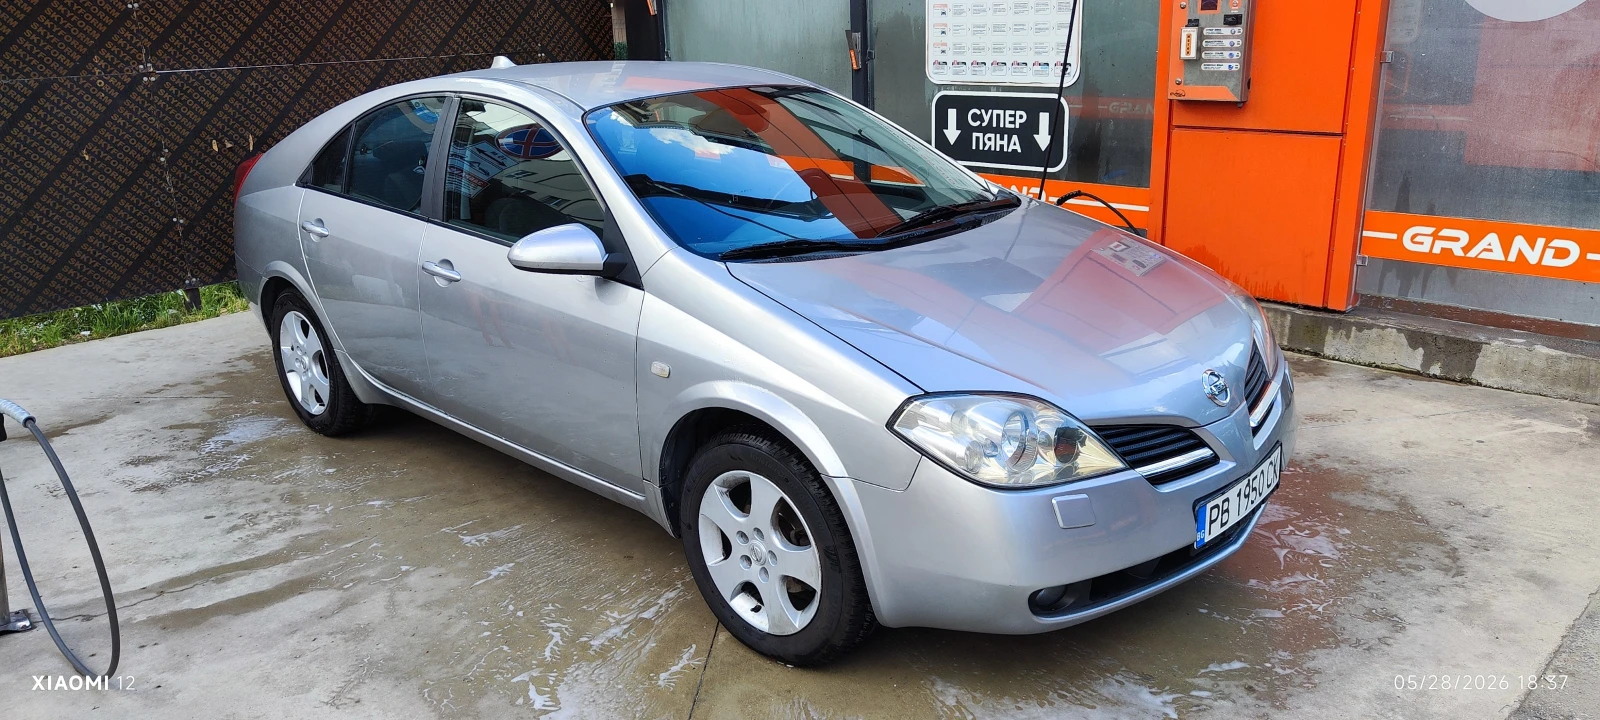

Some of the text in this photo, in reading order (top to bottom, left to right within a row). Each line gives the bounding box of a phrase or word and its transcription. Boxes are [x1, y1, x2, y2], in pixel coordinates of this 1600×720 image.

[44, 6, 94, 47] SKYFORM
[51, 0, 100, 40] SKYFORM
[187, 15, 229, 52] SKYFORM
[193, 8, 235, 46] SKYFORM
[199, 2, 241, 39] SKYFORM
[268, 14, 306, 50] SKYFORM
[274, 8, 311, 43] SKYFORM
[279, 1, 317, 37] SKYFORM
[342, 13, 376, 47] SKYFORM
[347, 7, 381, 41] SKYFORM
[352, 1, 386, 35] SKYFORM
[409, 12, 441, 45] SKYFORM
[414, 6, 446, 39] SKYFORM
[419, 0, 450, 33] SKYFORM
[23, 29, 74, 68] SKYFORM
[30, 21, 80, 61] SKYFORM
[37, 14, 87, 54] SKYFORM
[175, 29, 217, 66] SKYFORM
[181, 22, 223, 59] SKYFORM
[256, 27, 295, 62] SKYFORM
[262, 20, 300, 56] SKYFORM
[331, 25, 366, 59] SKYFORM
[336, 19, 371, 53] SKYFORM
[400, 24, 432, 56] SKYFORM
[404, 18, 437, 50] SKYFORM
[16, 36, 67, 75] SKYFORM
[170, 75, 212, 110] SKYFORM
[245, 77, 284, 111] SKYFORM
[251, 70, 290, 104] SKYFORM
[326, 66, 361, 98] SKYFORM
[38, 97, 87, 134] SKYFORM
[44, 90, 93, 126] SKYFORM
[51, 82, 100, 119] SKYFORM
[153, 96, 195, 131] SKYFORM
[158, 88, 201, 124] SKYFORM
[164, 82, 206, 117] SKYFORM
[228, 97, 268, 130] SKYFORM
[234, 90, 273, 124] SKYFORM
[240, 83, 279, 117] SKYFORM
[1109, 102, 1154, 114] GRAN
[24, 112, 74, 148] SKYFORM
[31, 105, 80, 141] SKYFORM
[111, 113, 156, 148] SKYFORM
[117, 106, 162, 140] SKYFORM
[223, 104, 262, 137] SKYFORM
[968, 108, 1027, 128] СУПЕР
[4, 135, 54, 170] SKYFORM
[10, 127, 61, 163] SKYFORM
[17, 120, 67, 156] SKYFORM
[92, 135, 138, 169] SKYFORM
[98, 128, 144, 162] SKYFORM
[105, 120, 150, 155] SKYFORM
[194, 138, 235, 171] SKYFORM
[972, 132, 1022, 152] ПЯНА
[73, 157, 120, 191] SKYFORM
[86, 142, 132, 176] SKYFORM
[176, 159, 218, 192] SKYFORM
[182, 152, 224, 185] SKYFORM
[188, 145, 229, 178] SKYFORM
[53, 179, 101, 212] SKYFORM
[60, 172, 107, 205] SKYFORM
[66, 164, 113, 198] SKYFORM
[170, 166, 212, 198] SKYFORM
[40, 194, 88, 227] SKYFORM
[46, 187, 95, 220] SKYFORM
[118, 199, 163, 230] SKYFORM
[124, 192, 169, 223] SKYFORM
[131, 184, 175, 216] SKYFORM
[20, 217, 69, 250] SKYFORM
[27, 209, 76, 242] SKYFORM
[33, 202, 82, 235] SKYFORM
[106, 213, 151, 245] SKYFORM
[112, 206, 157, 238] SKYFORM
[7, 232, 56, 265] SKYFORM
[13, 224, 63, 257] SKYFORM
[87, 235, 133, 266] SKYFORM
[93, 228, 139, 259] SKYFORM
[100, 221, 145, 252] SKYFORM
[188, 233, 229, 264] SKYFORM
[194, 226, 234, 257] SKYFORM
[1402, 226, 1580, 268] GRAND
[0, 240, 50, 272] SKYFORM
[74, 250, 121, 281] SKYFORM
[81, 243, 127, 274] SKYFORM
[150, 252, 191, 282] SKYFORM
[182, 240, 223, 270] SKYFORM
[55, 273, 102, 303] SKYFORM
[62, 265, 108, 296] SKYFORM
[68, 258, 114, 288] SKYFORM
[144, 260, 186, 289] SKYFORM
[1208, 497, 1230, 536] PB
[1236, 469, 1265, 516] 1950
[1197, 530, 1204, 541] BG
